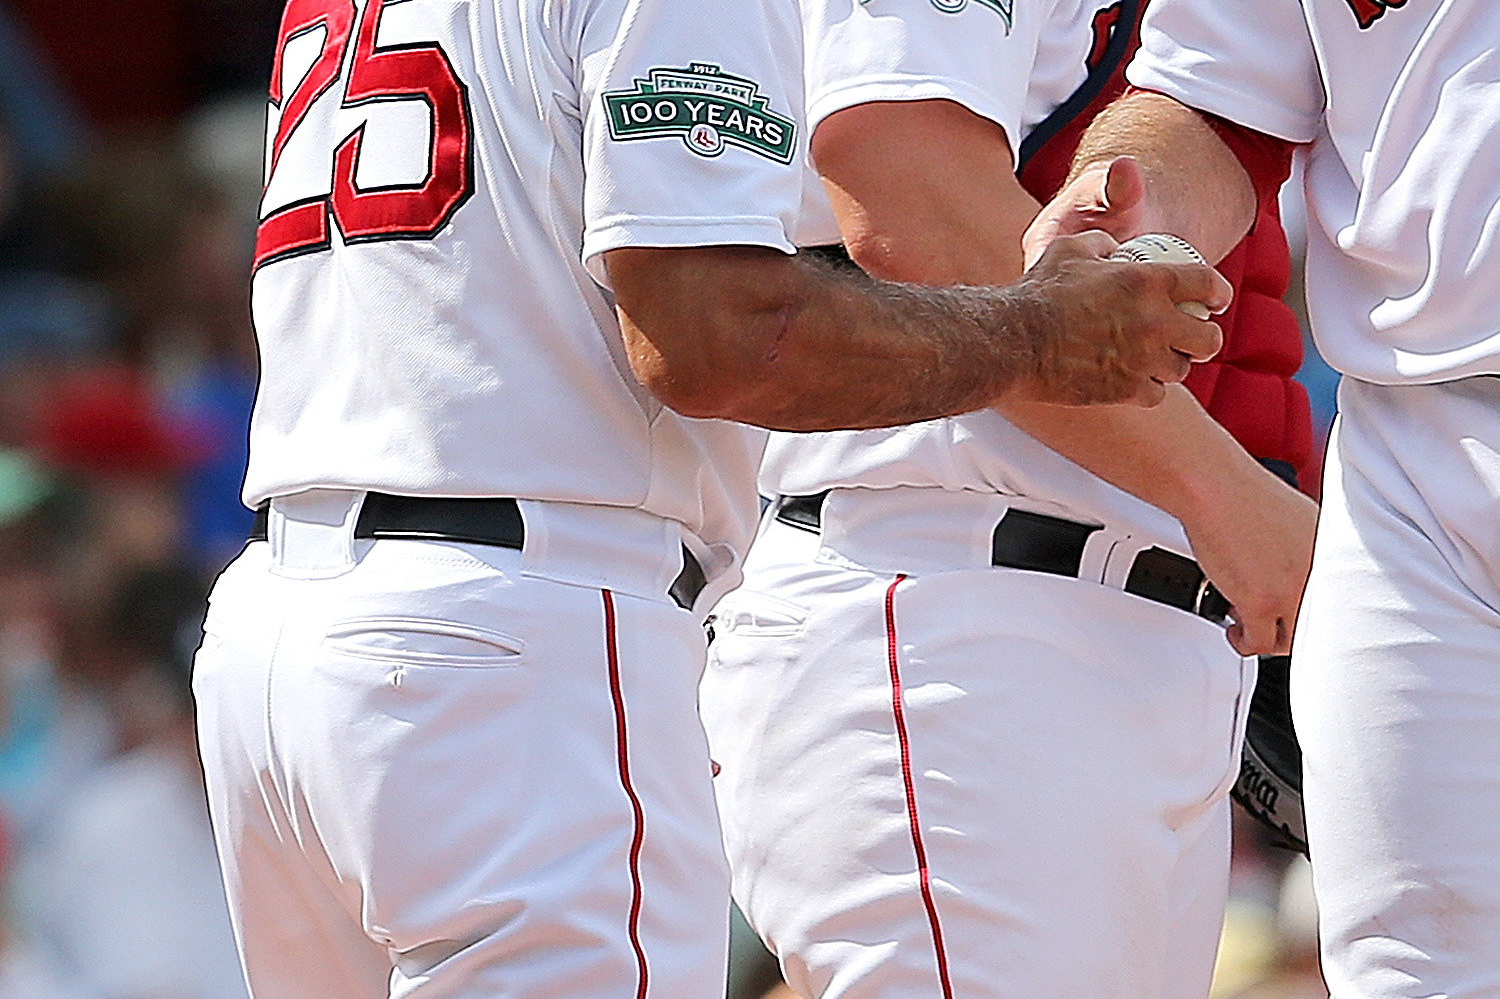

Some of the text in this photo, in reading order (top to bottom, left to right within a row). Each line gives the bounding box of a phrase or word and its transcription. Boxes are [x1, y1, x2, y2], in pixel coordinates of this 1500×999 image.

[660, 79, 747, 99] FENWAY PARK
[620, 100, 784, 146] 100 YEARS
